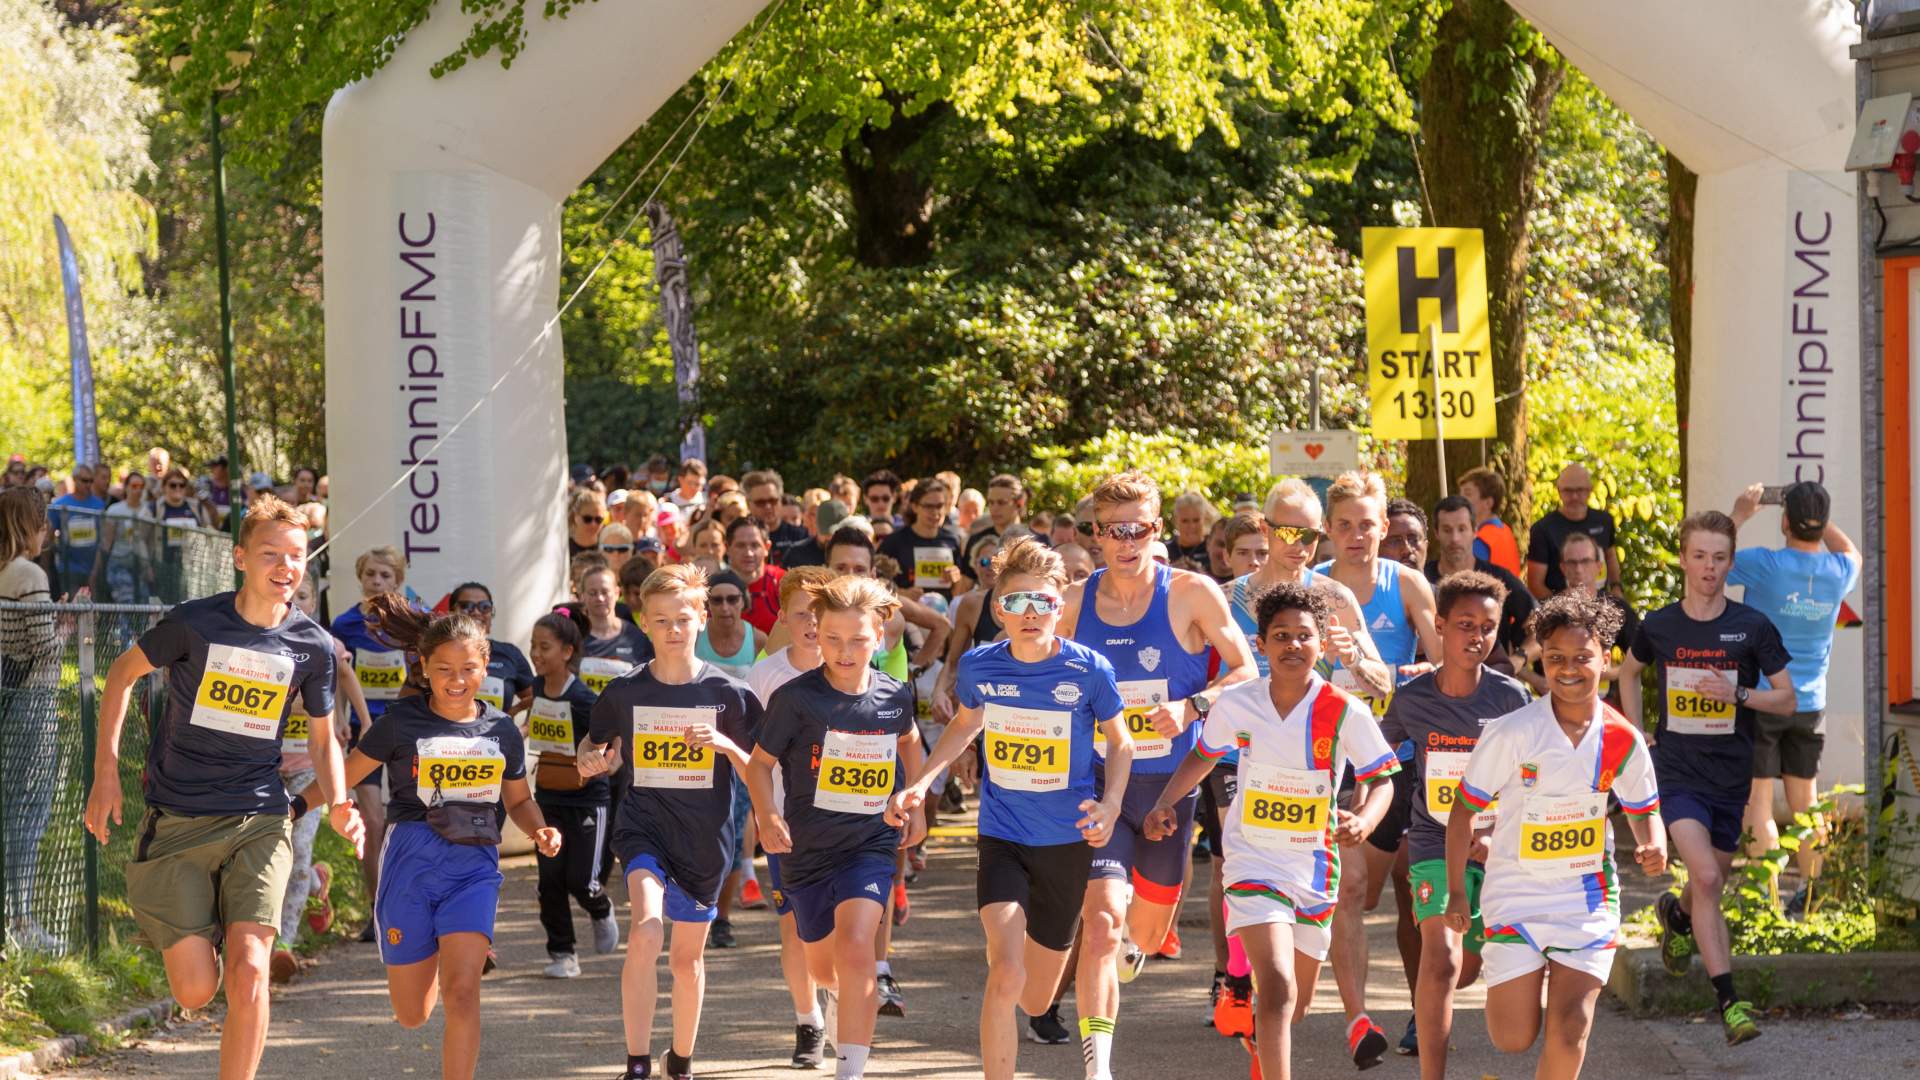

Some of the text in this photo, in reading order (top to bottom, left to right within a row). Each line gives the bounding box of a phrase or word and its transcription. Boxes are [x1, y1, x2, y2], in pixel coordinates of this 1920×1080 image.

[1397, 247, 1459, 334] H
[1787, 211, 1833, 486] chnipFMC
[1381, 351, 1480, 379] START
[399, 212, 443, 568] TechnipFMC
[1394, 390, 1475, 419] 13:30
[209, 680, 277, 711] 8067
[1675, 695, 1726, 713] 8160
[533, 720, 566, 738] 8066
[1005, 725, 1047, 736] MARATHON
[643, 741, 704, 763] 8128
[846, 751, 883, 760] MARATHON
[994, 740, 1055, 765] 8791
[429, 764, 495, 781] 8065
[829, 766, 889, 788] 8360
[1012, 763, 1037, 772] DANIEL
[1268, 784, 1311, 795] MARATHON
[1253, 799, 1316, 824] 8891
[1531, 827, 1595, 852] 8890
